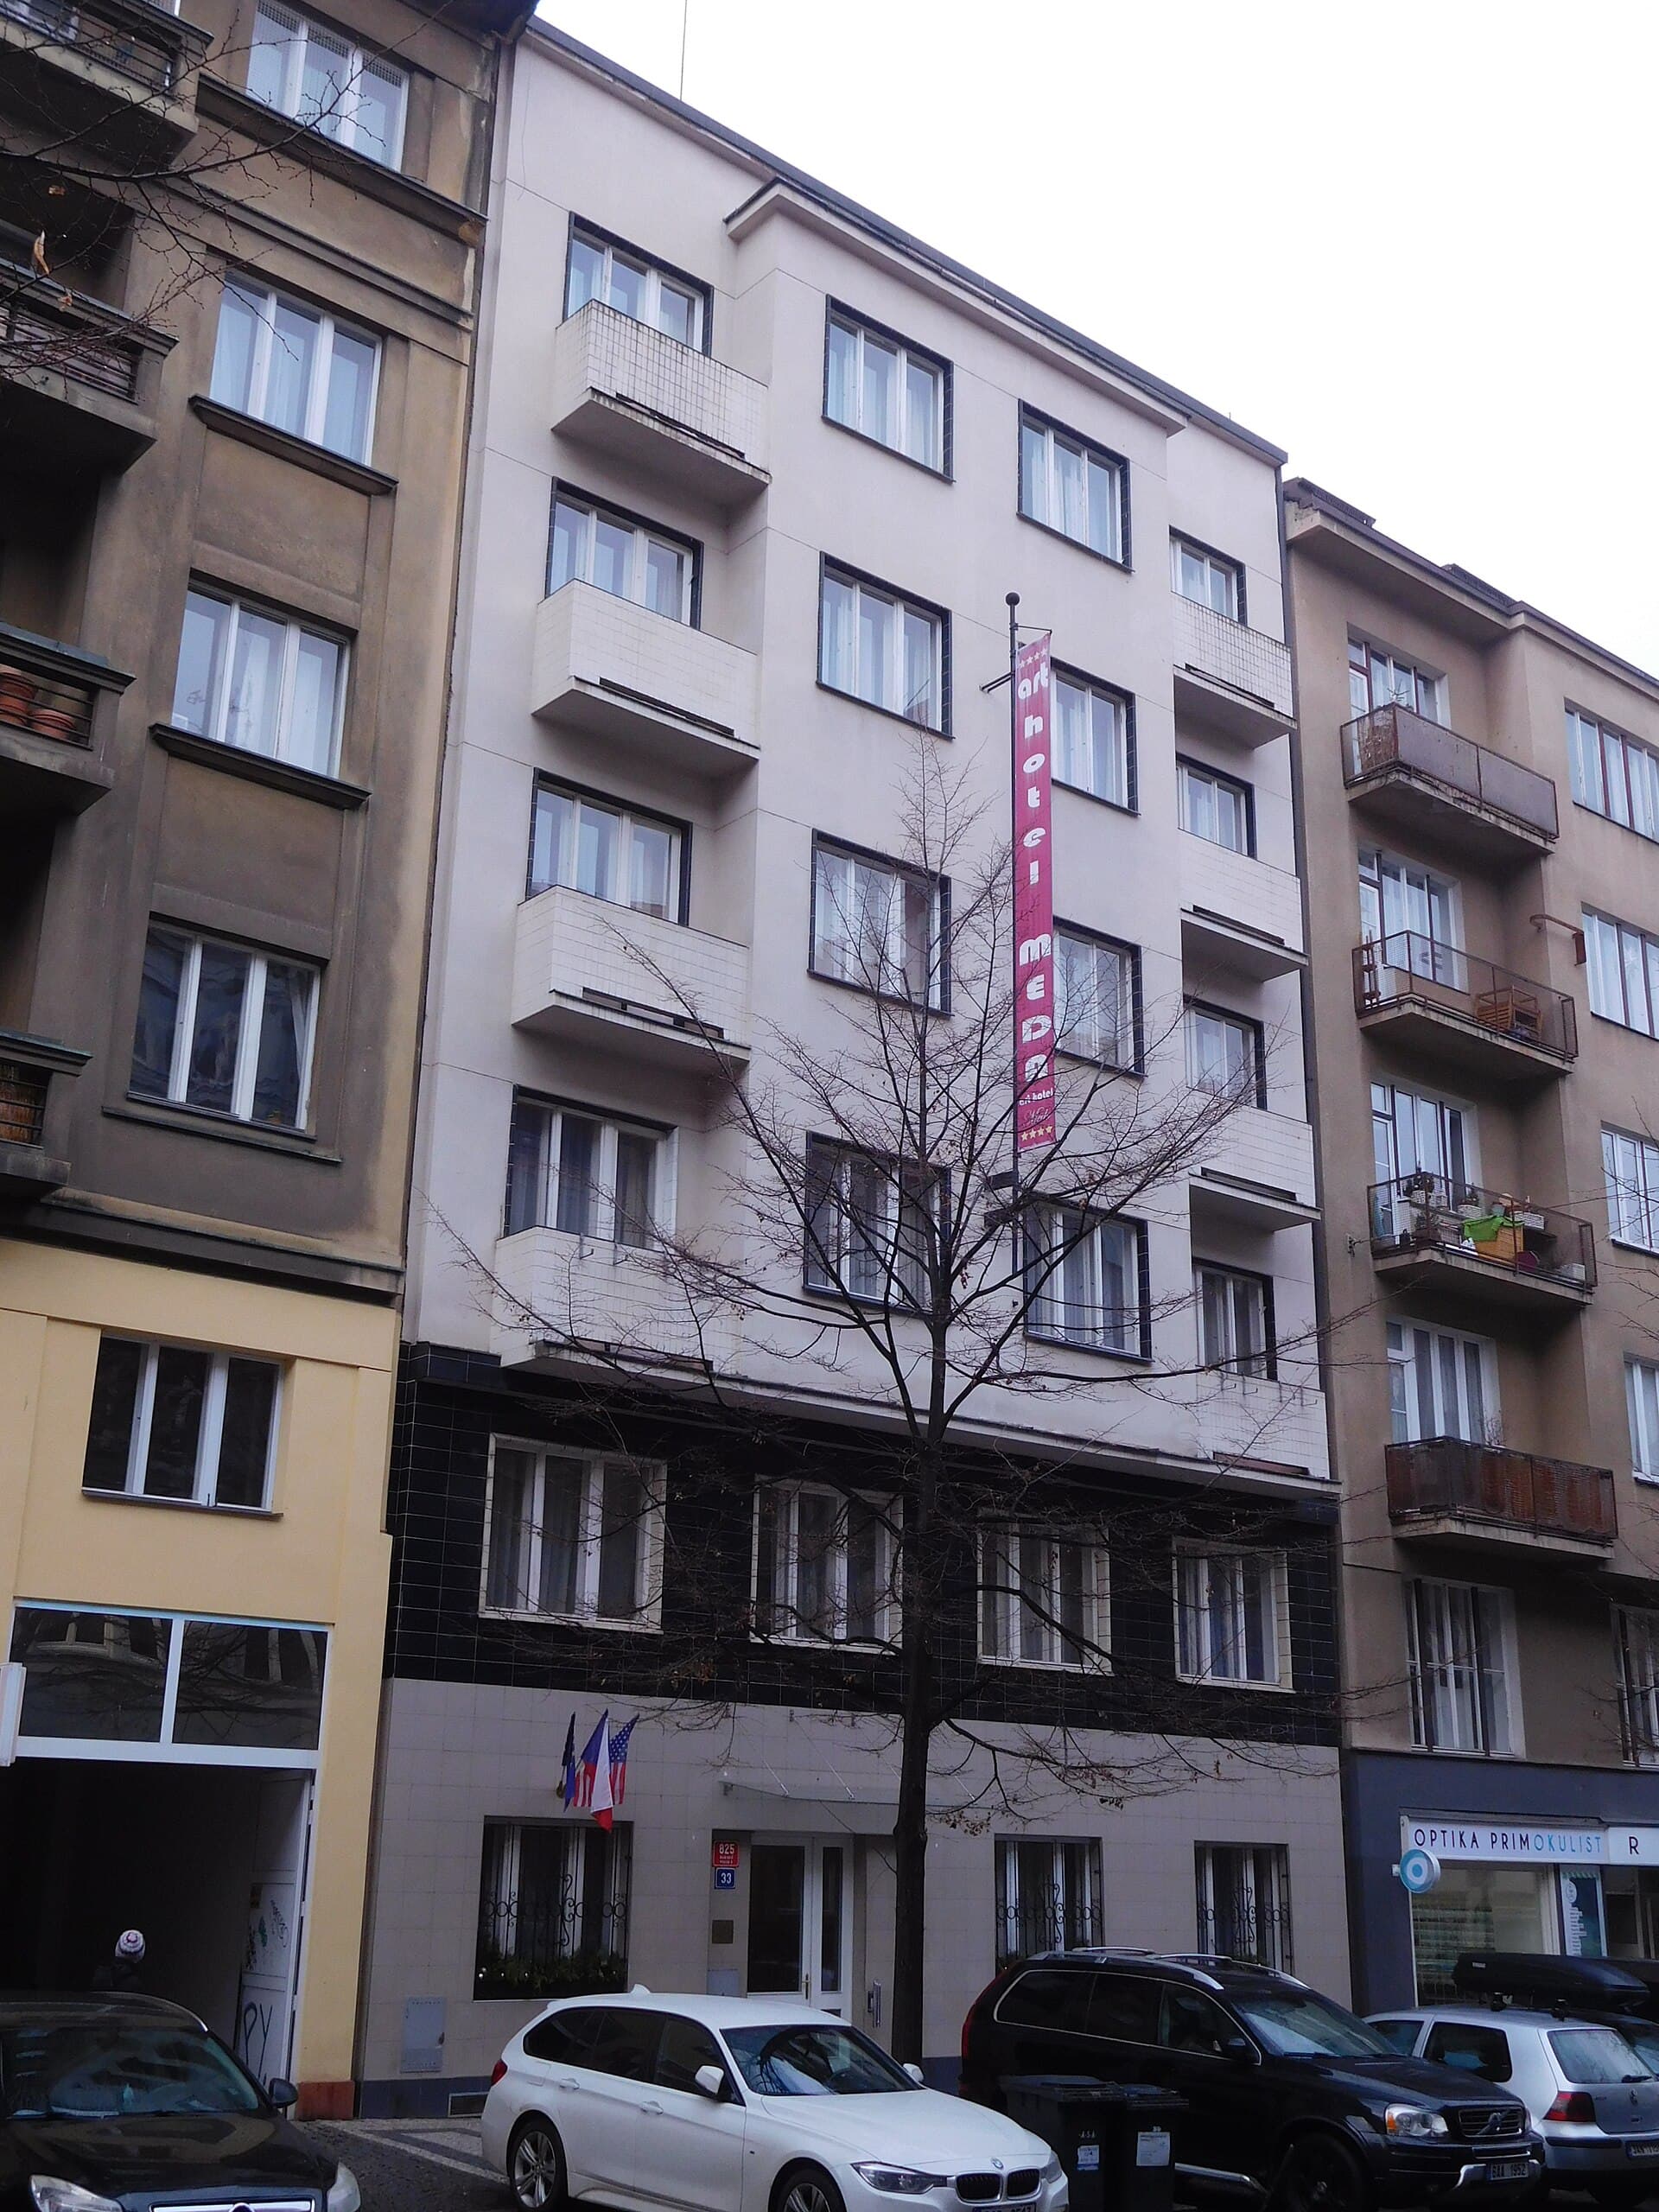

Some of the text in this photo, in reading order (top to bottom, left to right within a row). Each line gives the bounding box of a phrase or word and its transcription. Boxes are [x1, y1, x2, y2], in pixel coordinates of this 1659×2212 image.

[1018, 662, 1048, 700] art
[719, 1843, 734, 1854] 825
[1414, 1828, 1601, 1853] OPTIKA PRIMOKULIST
[721, 1872, 732, 1884] 33
